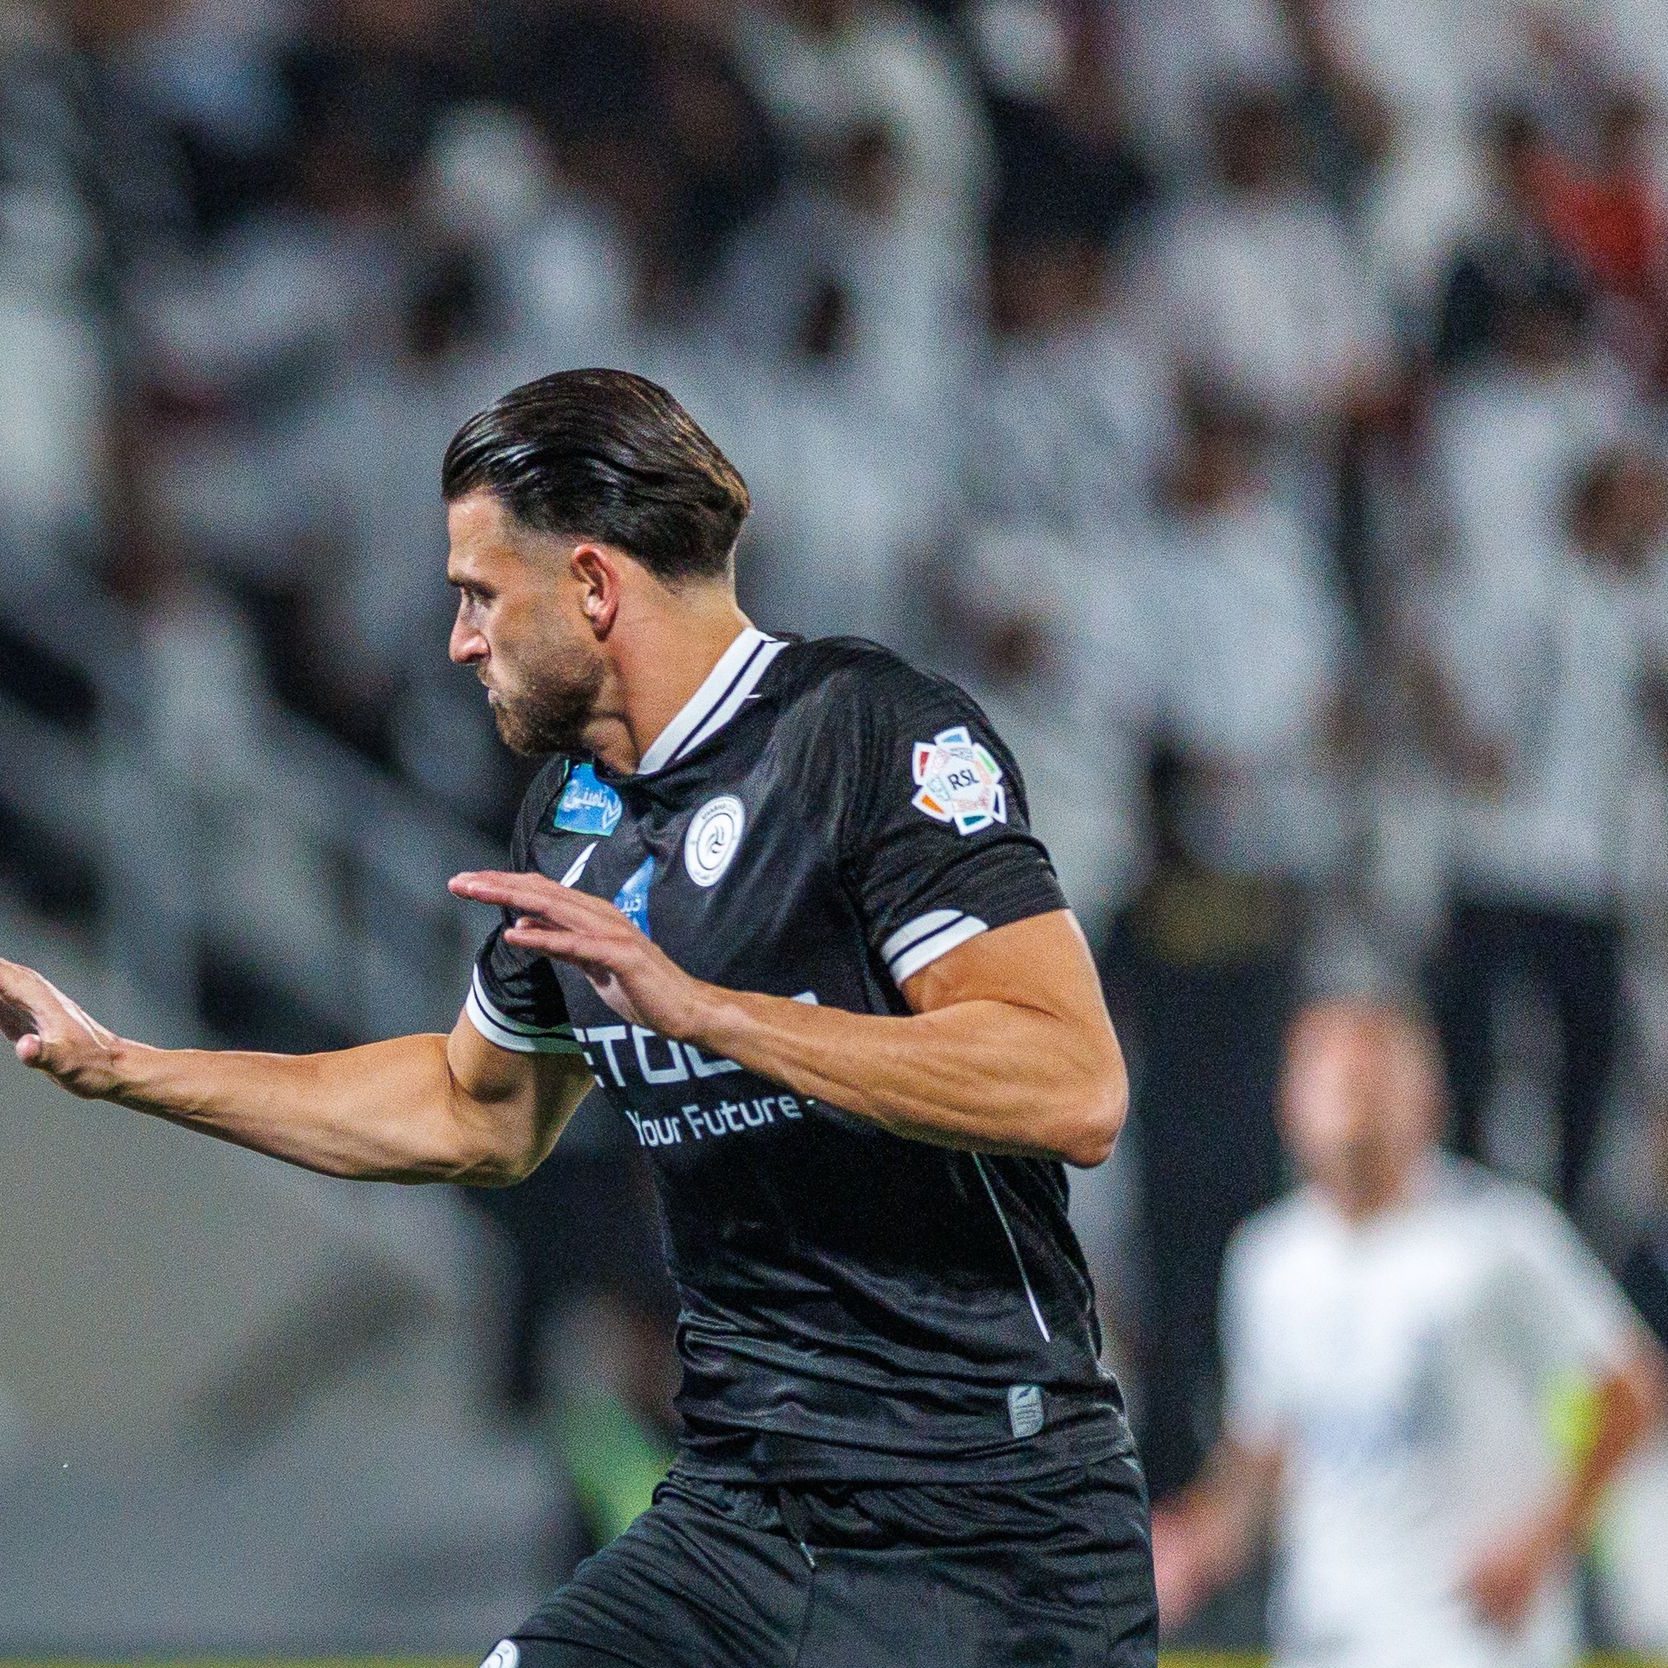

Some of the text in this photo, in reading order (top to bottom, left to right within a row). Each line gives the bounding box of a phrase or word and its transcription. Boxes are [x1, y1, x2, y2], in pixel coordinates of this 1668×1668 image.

[947, 768, 979, 791] RSL
[625, 1095, 803, 1148] Your Future
